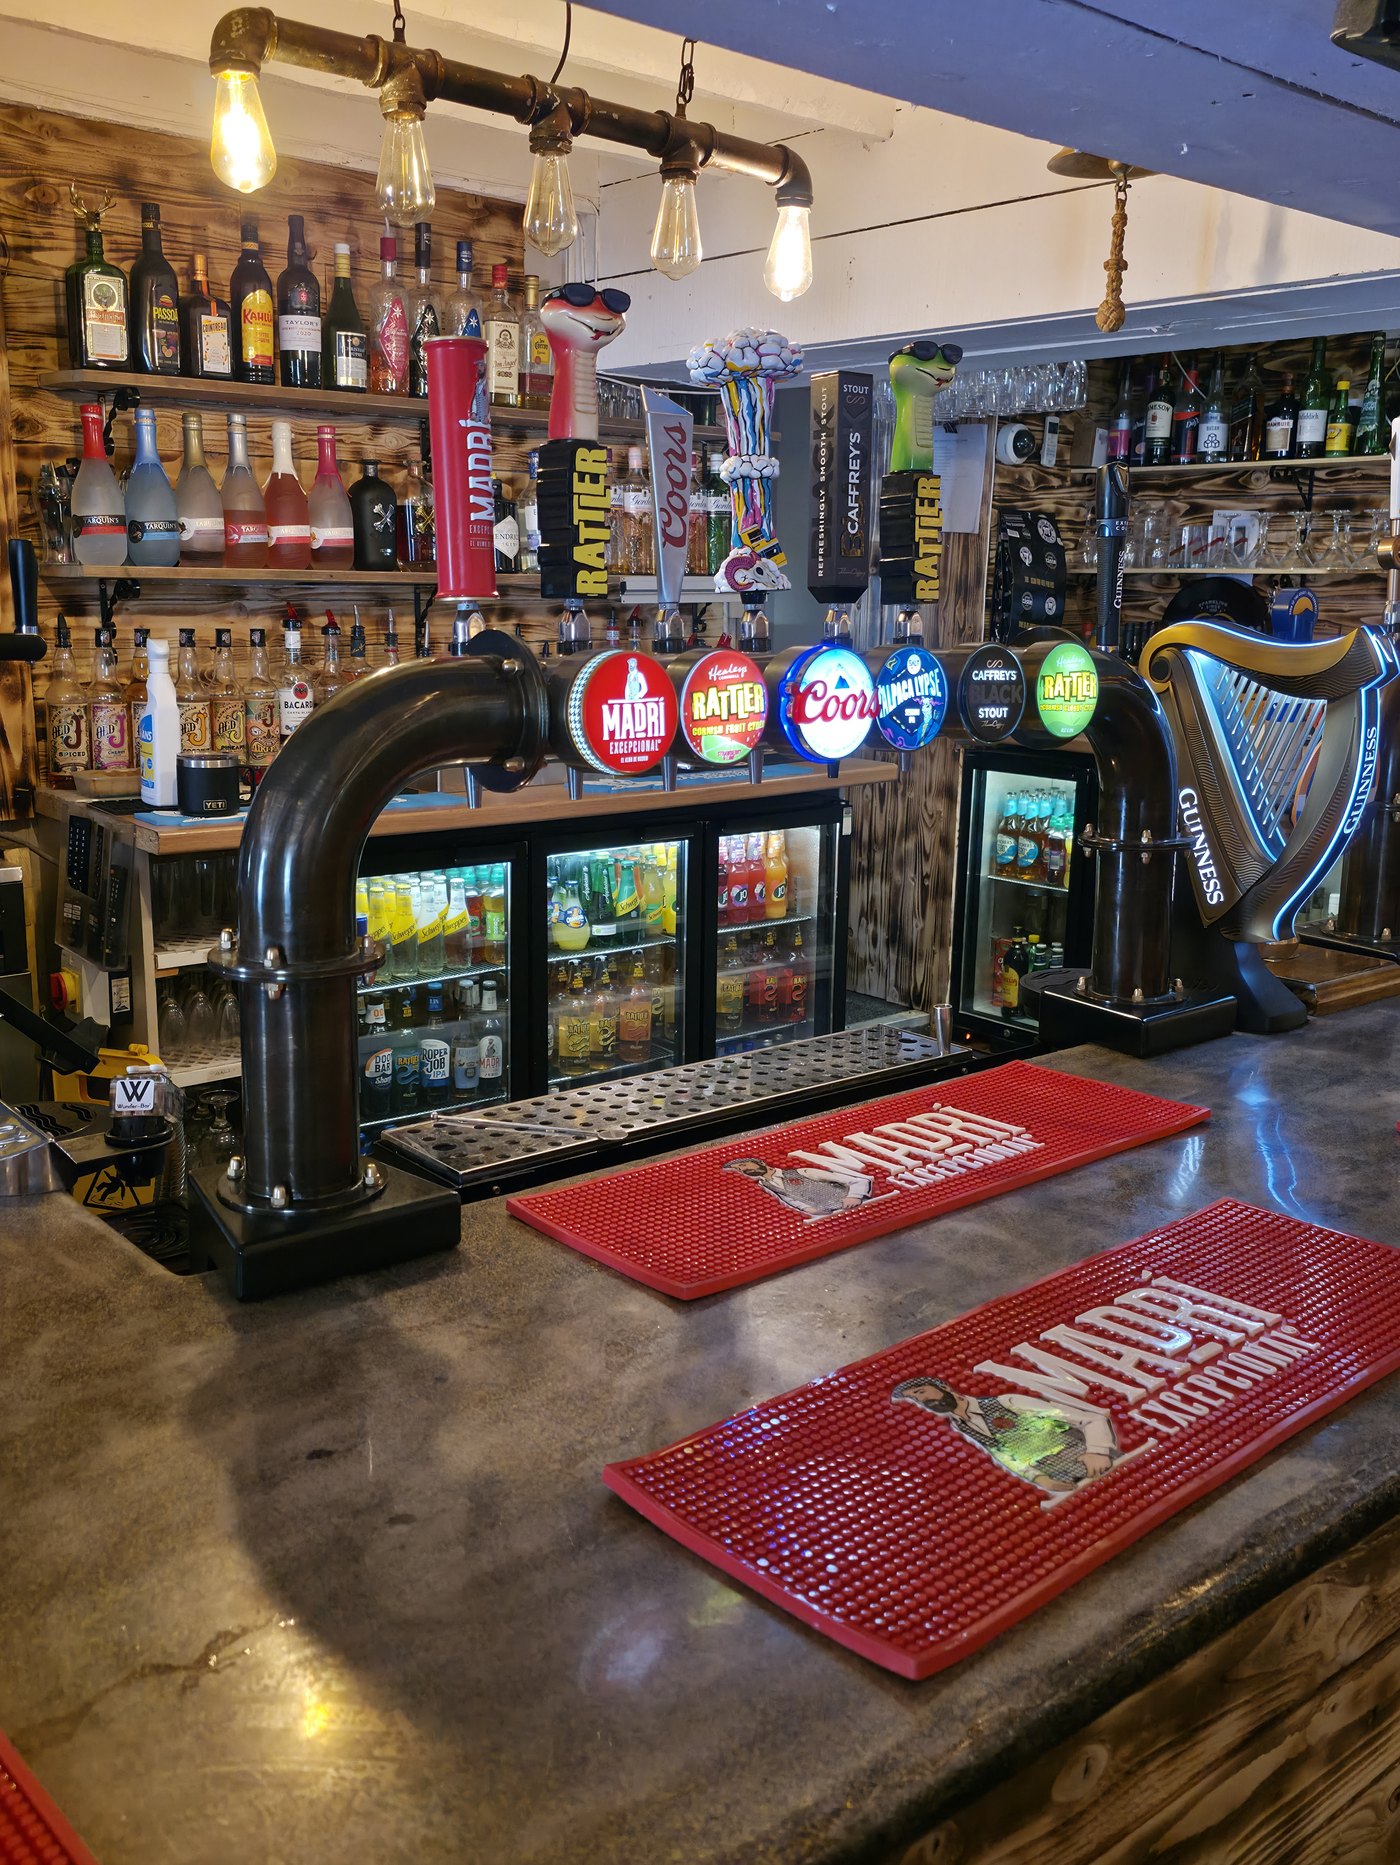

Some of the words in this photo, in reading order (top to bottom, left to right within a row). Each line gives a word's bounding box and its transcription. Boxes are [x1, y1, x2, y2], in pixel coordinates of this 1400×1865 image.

[821, 386, 829, 425] STOUT
[843, 383, 870, 395] STOUT
[819, 431, 828, 483] SMOOTH
[659, 421, 688, 549] Coors
[847, 431, 862, 536] CAFFREY'S
[83, 516, 120, 525] TARQUIN'S
[572, 446, 612, 597] RATTLER
[817, 490, 827, 578] REFRESHINGLY
[914, 476, 945, 603] RATTLER
[1113, 550, 1126, 609] GUINNESS
[968, 683, 1023, 705] BLACK
[971, 669, 1018, 681] CAFFREY'S
[1043, 670, 1098, 703] RATTLER
[602, 696, 666, 741] MADRÍ
[691, 681, 766, 721] RATTLER
[791, 680, 881, 725] Coors
[978, 707, 1009, 719] STOUT
[63, 708, 84, 750] J
[107, 708, 127, 749] J
[187, 707, 209, 747] J
[229, 710, 245, 744] J
[725, 722, 746, 735] FRUIT
[58, 750, 87, 758] SPICED
[609, 740, 662, 755] EXCEPCIONAL
[1343, 726, 1378, 834] GUINNESS
[1179, 787, 1225, 906] GUINNESS
[374, 1063, 391, 1073] BAR
[421, 1046, 448, 1061] ROPER
[426, 1057, 446, 1074] JOB
[480, 1057, 500, 1069] MADR
[120, 1080, 151, 1103] W
[432, 1070, 447, 1079] IPA
[116, 1102, 151, 1110] Wunder-Bar
[787, 1101, 1028, 1182] MADRÍ
[886, 1132, 1046, 1191] EXCEPCIONAL
[973, 1269, 1284, 1417] MADRÍ
[1127, 1324, 1322, 1436] EXCEPCIONAL
